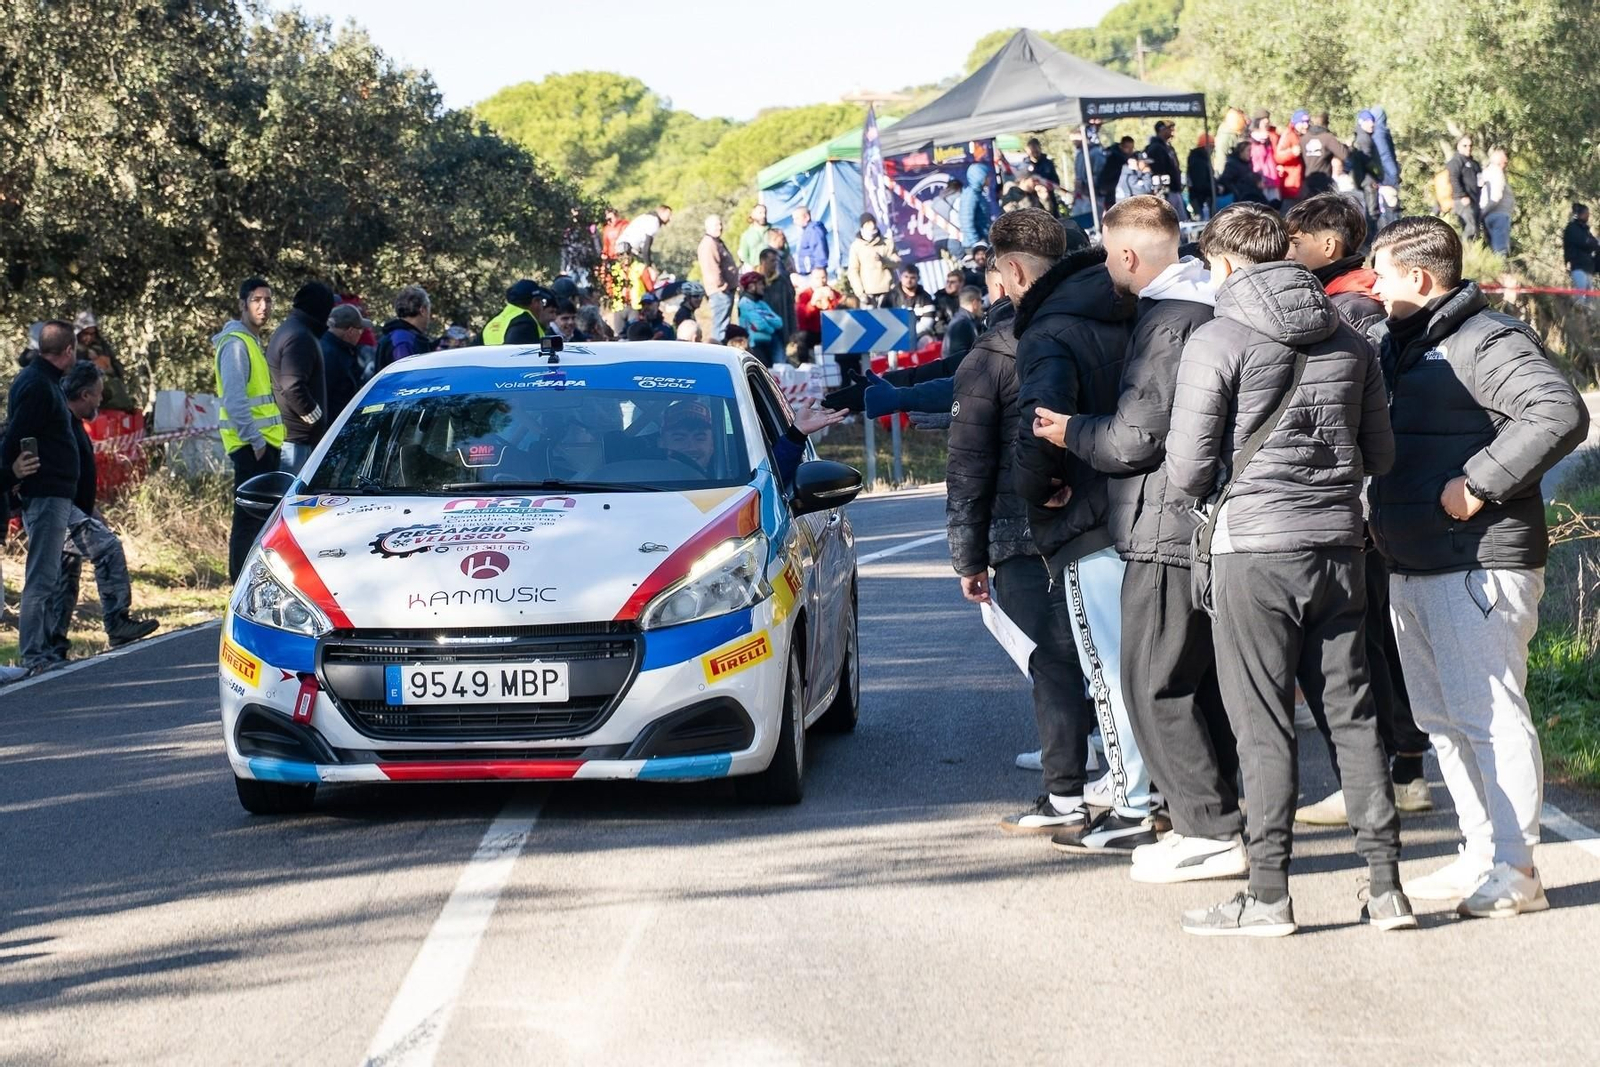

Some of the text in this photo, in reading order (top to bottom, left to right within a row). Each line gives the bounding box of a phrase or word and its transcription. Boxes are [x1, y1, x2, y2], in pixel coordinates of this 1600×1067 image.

[1115, 102, 1129, 114] QUE
[633, 376, 696, 384] SPORTS
[469, 445, 495, 454] OMP
[397, 525, 535, 540] RECAMBIOS
[414, 532, 507, 545] VELASCO
[222, 641, 256, 680] PIRELLI
[709, 637, 768, 676] PIRELLI
[410, 669, 559, 699] 9549 MBP
[391, 688, 398, 697] E
